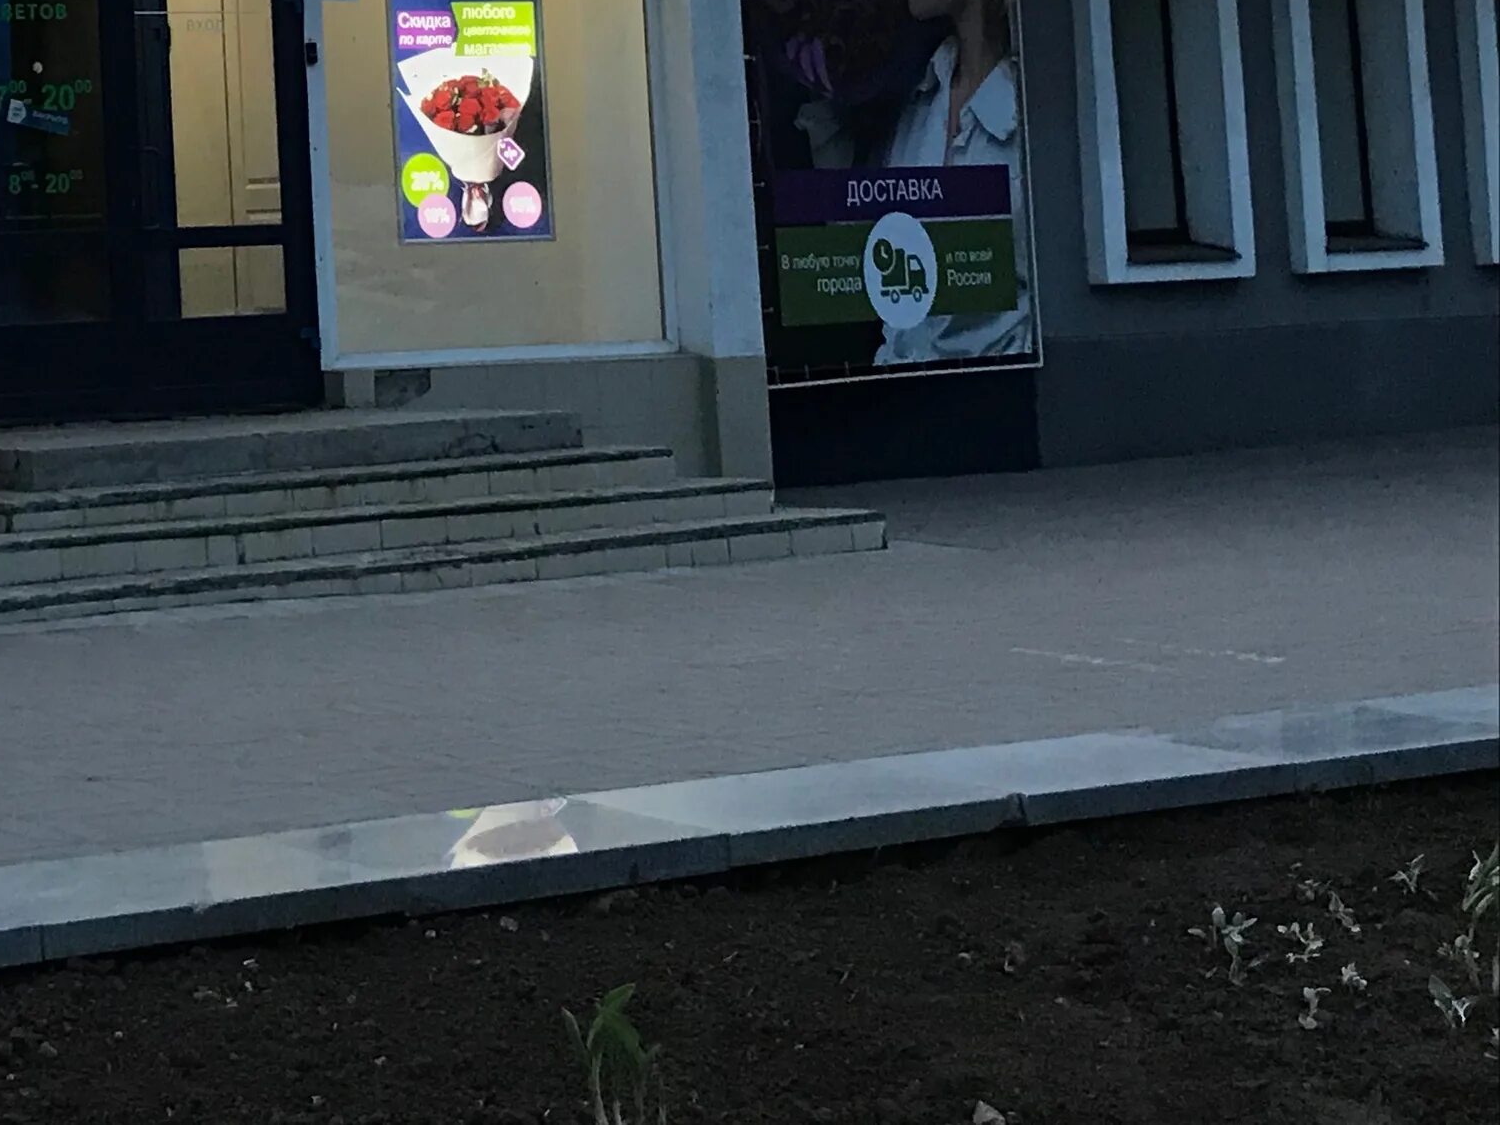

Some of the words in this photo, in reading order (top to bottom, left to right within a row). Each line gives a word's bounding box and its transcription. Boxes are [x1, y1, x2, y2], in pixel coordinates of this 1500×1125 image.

[397, 11, 452, 31] Скидка
[461, 3, 516, 20] любого
[463, 25, 532, 37] цветочн
[398, 34, 415, 46] по
[416, 34, 453, 48] карте
[463, 42, 532, 56] мага
[846, 178, 944, 207] ДОСТАВКА
[781, 256, 790, 270] В
[792, 252, 831, 272] любую
[817, 276, 863, 296] города
[946, 268, 992, 287] России
